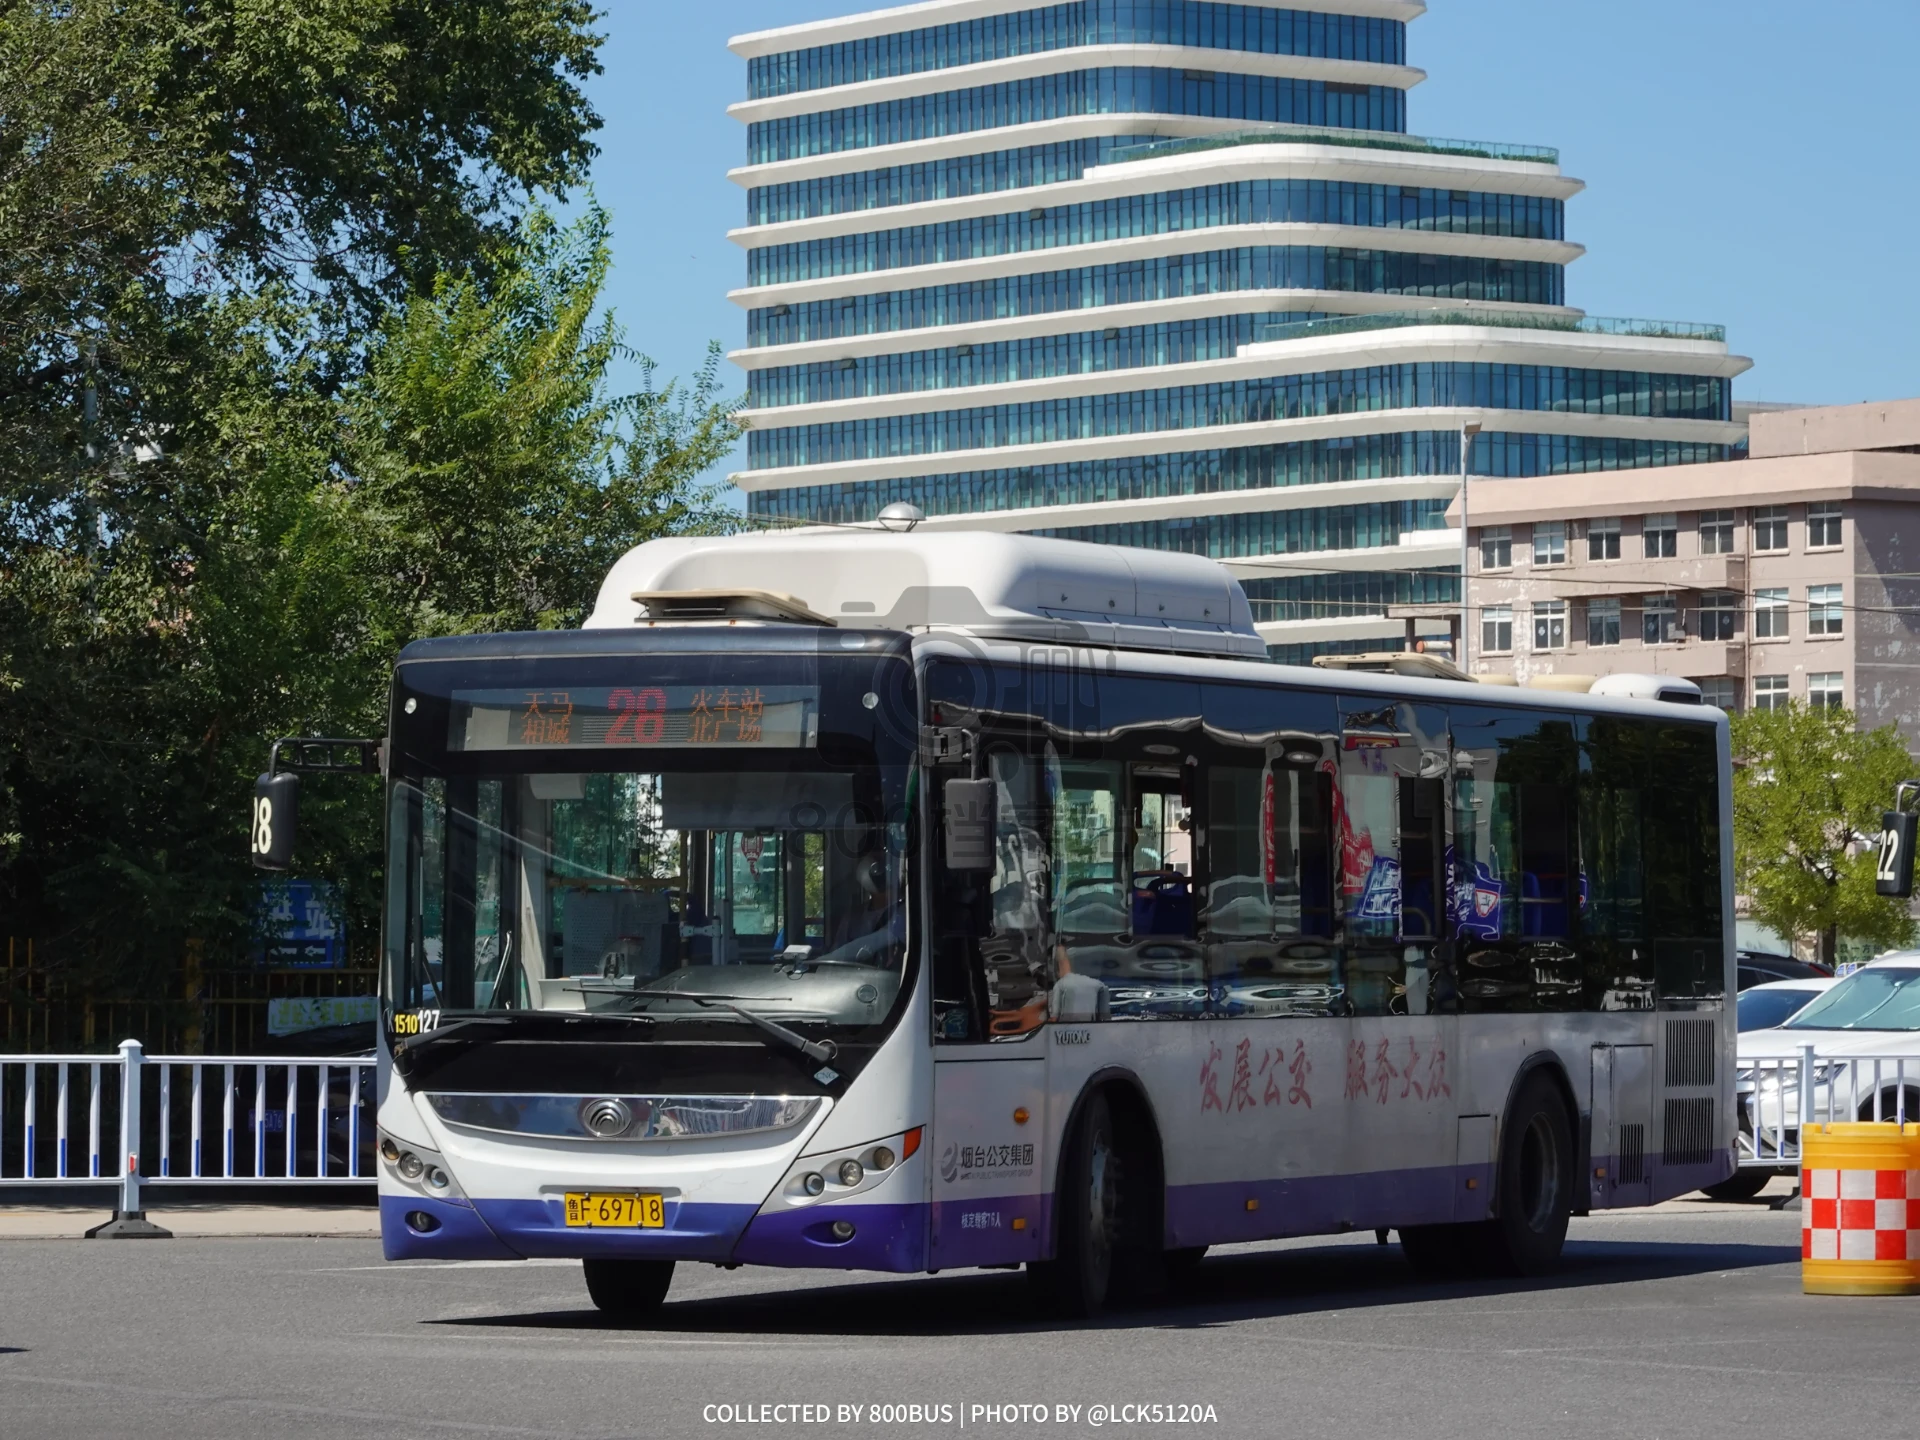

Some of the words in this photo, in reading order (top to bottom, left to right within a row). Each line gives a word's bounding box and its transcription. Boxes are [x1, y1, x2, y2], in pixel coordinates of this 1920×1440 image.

[521, 691, 573, 718] 天马
[605, 688, 667, 744] 28
[689, 688, 765, 717] 火车站
[687, 717, 762, 743] 北广场
[252, 797, 272, 854] 28
[1876, 829, 1899, 880] 22
[1054, 1029, 1092, 1046] YUTONG
[961, 1143, 1034, 1169] 烟台公交集团
